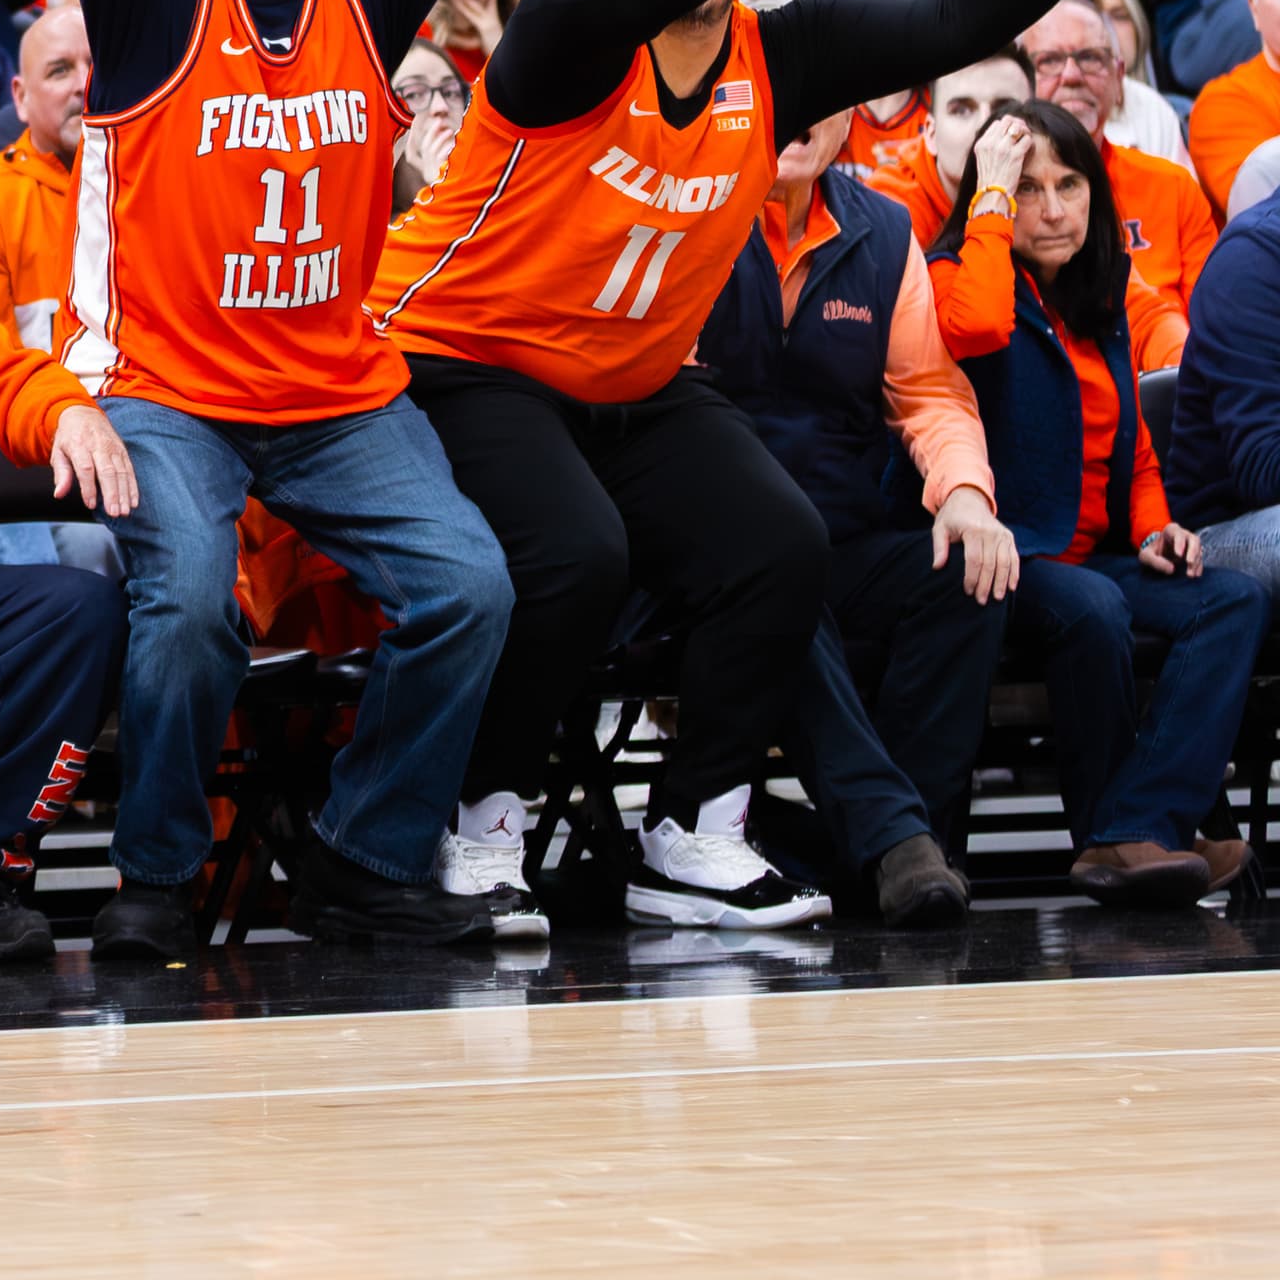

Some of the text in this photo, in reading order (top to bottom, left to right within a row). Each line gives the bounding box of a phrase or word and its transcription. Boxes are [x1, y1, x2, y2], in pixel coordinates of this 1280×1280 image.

[254, 165, 323, 245] 11
[1123, 219, 1152, 251] I
[218, 243, 342, 309] ILLINI
[592, 223, 687, 320] 11
